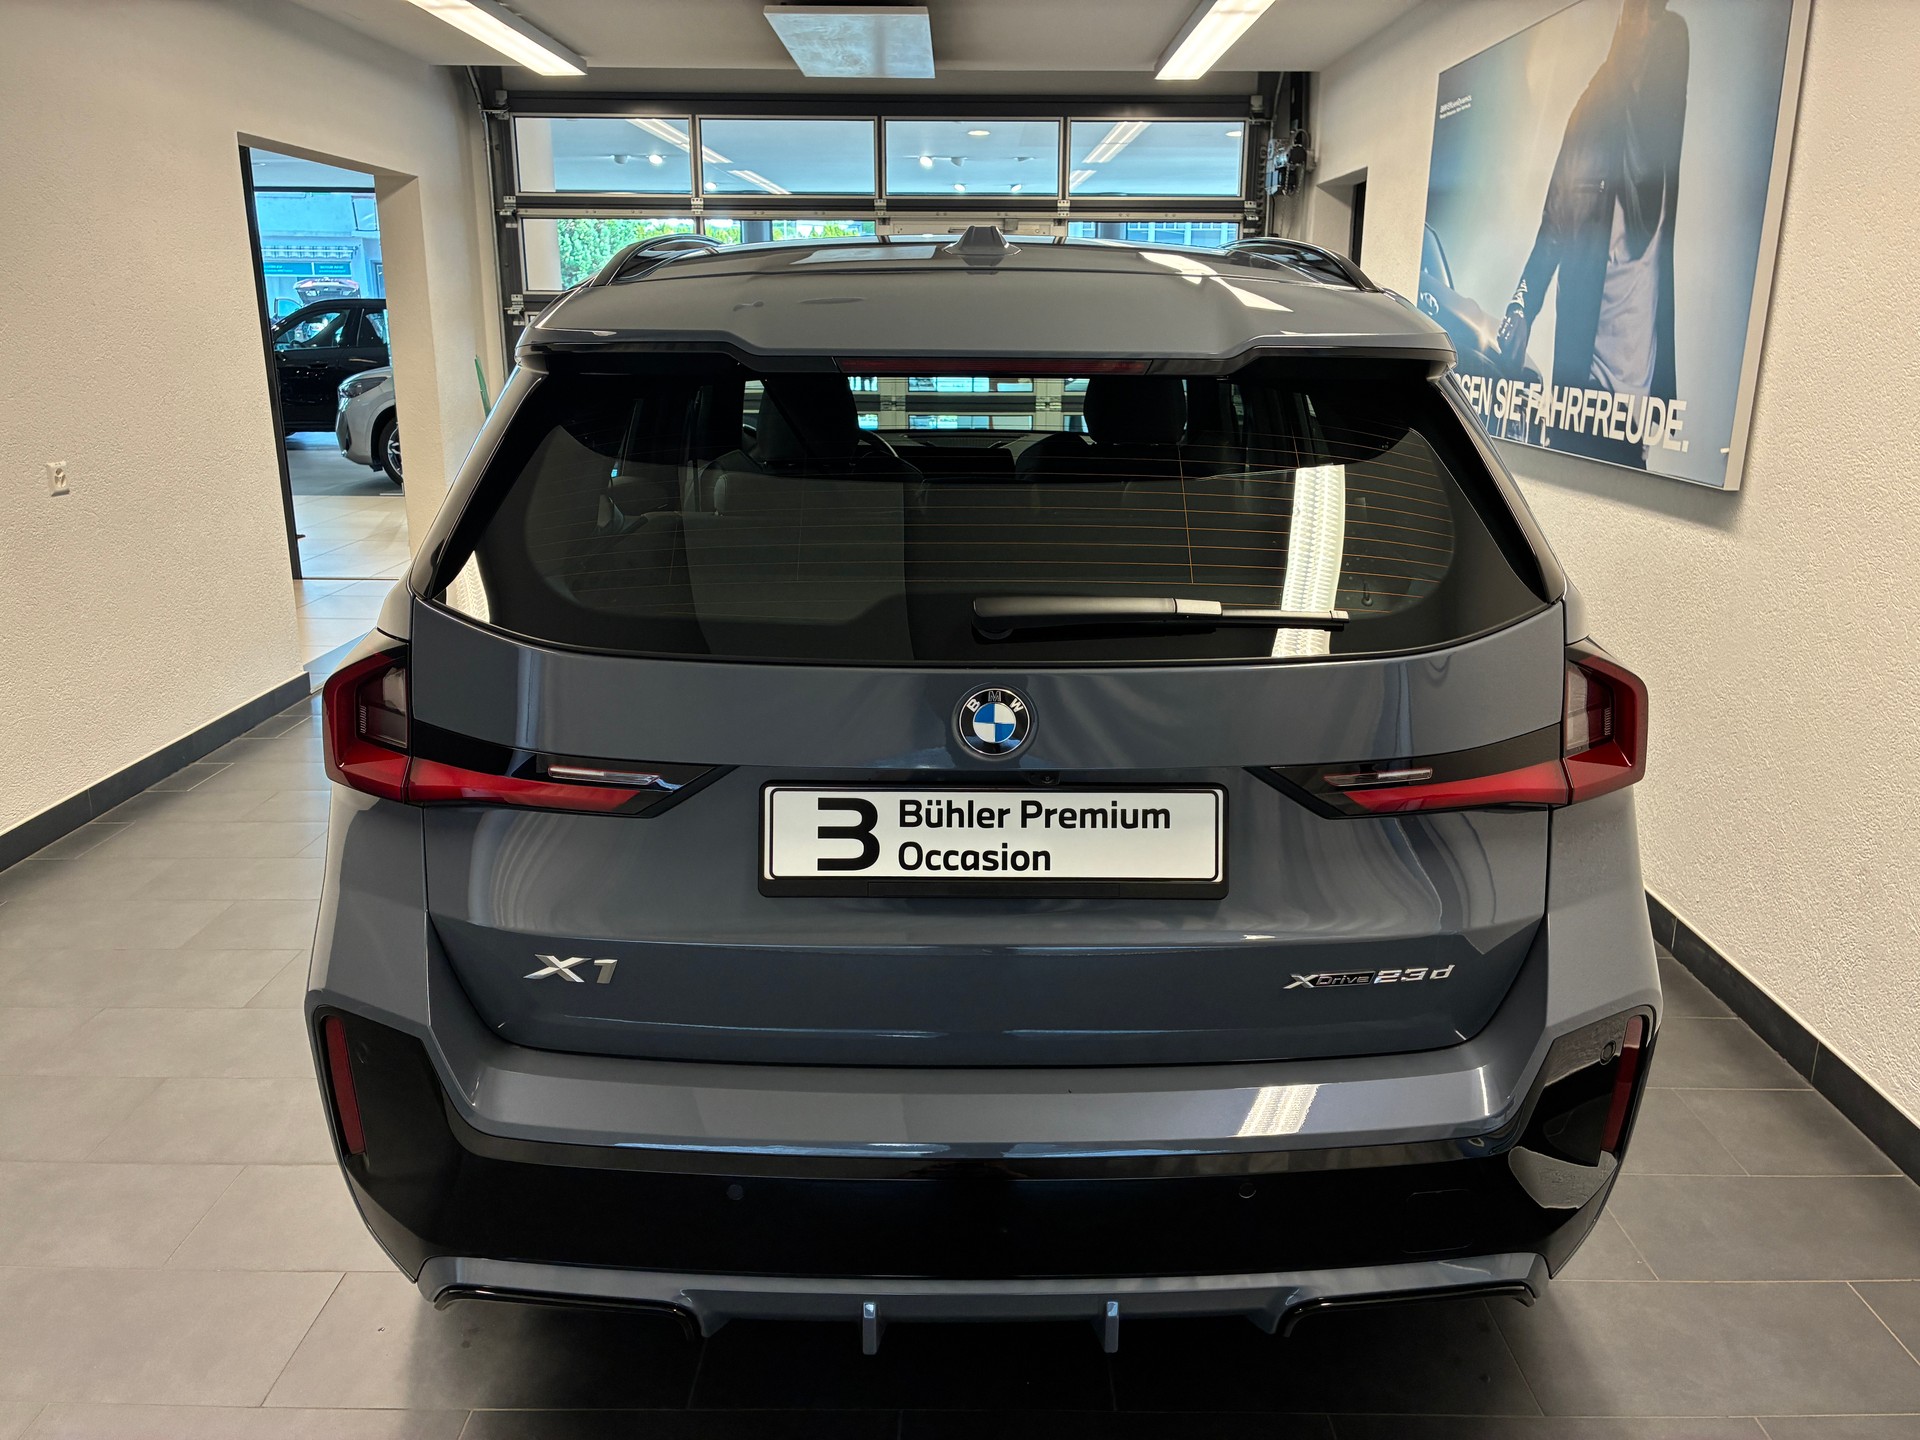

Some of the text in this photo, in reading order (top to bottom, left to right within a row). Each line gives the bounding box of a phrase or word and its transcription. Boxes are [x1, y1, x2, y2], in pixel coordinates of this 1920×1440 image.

[1494, 378, 1525, 421] SIE
[1527, 382, 1689, 453] FAHRFREUDE.
[966, 690, 1024, 713] BMW
[898, 799, 1171, 829] Bühler Premium
[898, 840, 1052, 872] Occasion
[523, 953, 618, 984] X1
